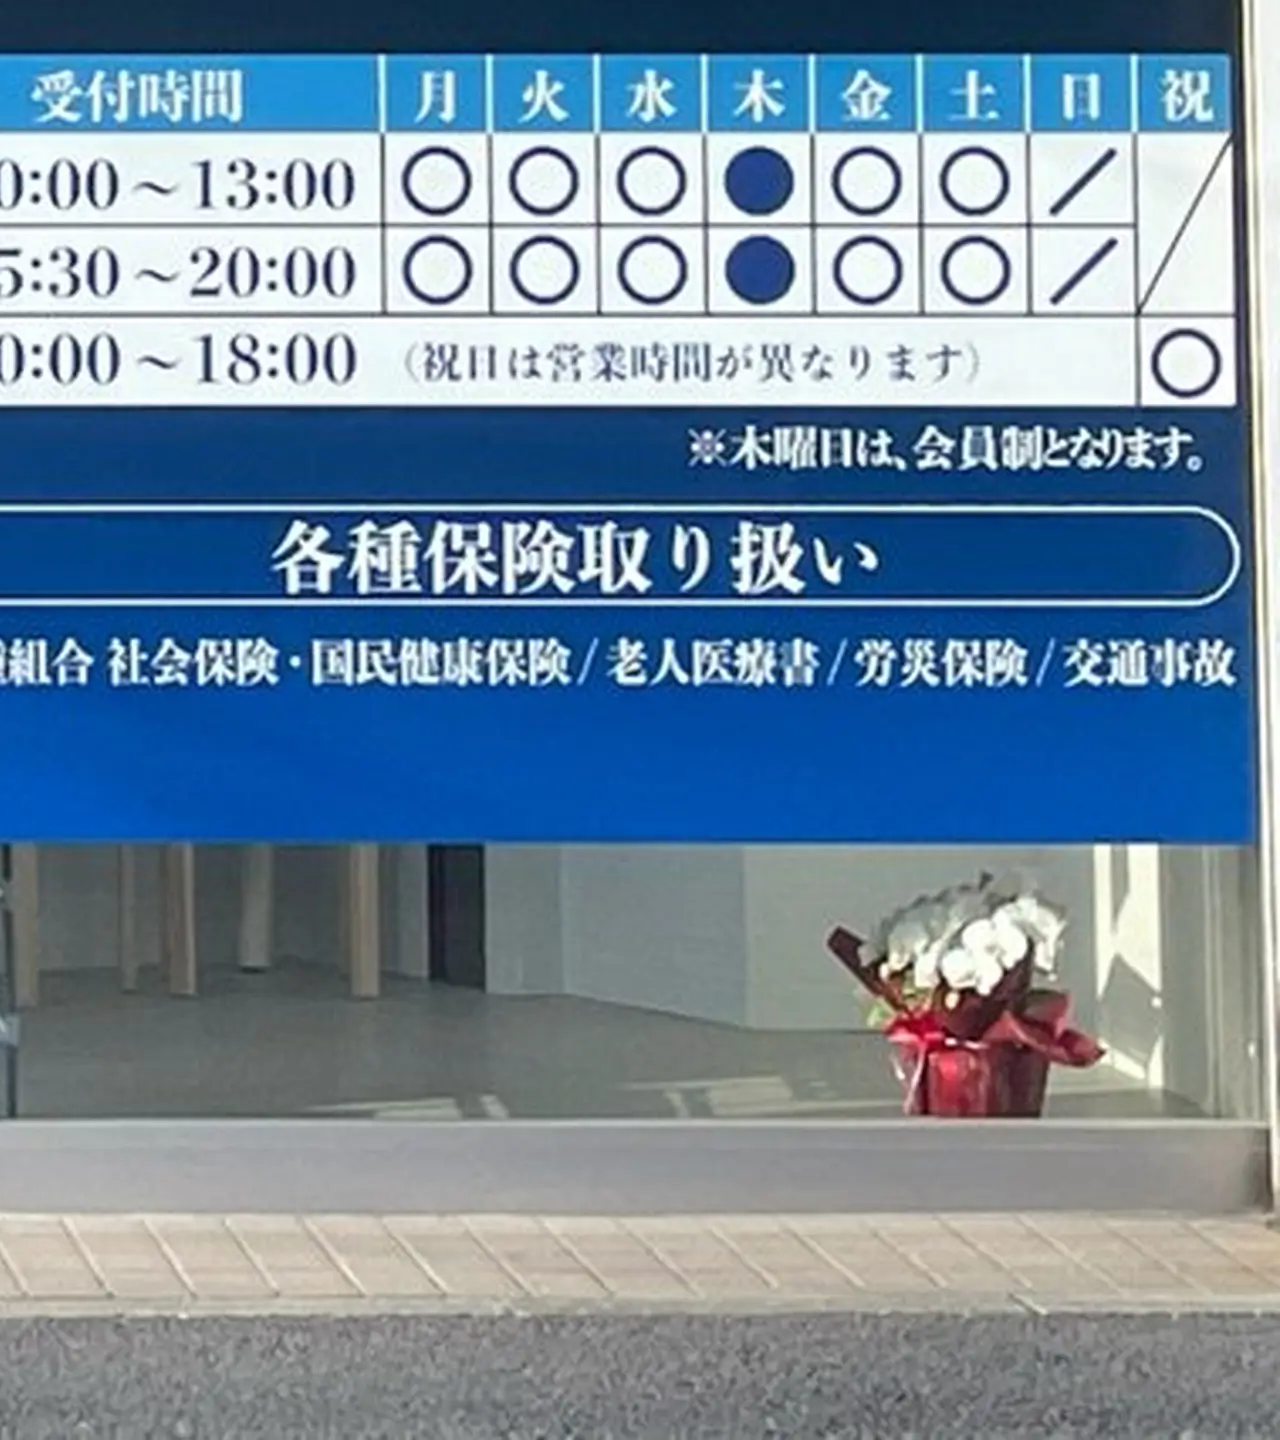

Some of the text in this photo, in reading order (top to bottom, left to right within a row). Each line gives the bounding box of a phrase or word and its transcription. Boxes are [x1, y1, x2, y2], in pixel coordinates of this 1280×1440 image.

[31, 69, 1214, 123] 受付時間 月 火 水 木 金 土 日 祝
[272, 519, 878, 595] 各種保険取り扱い
